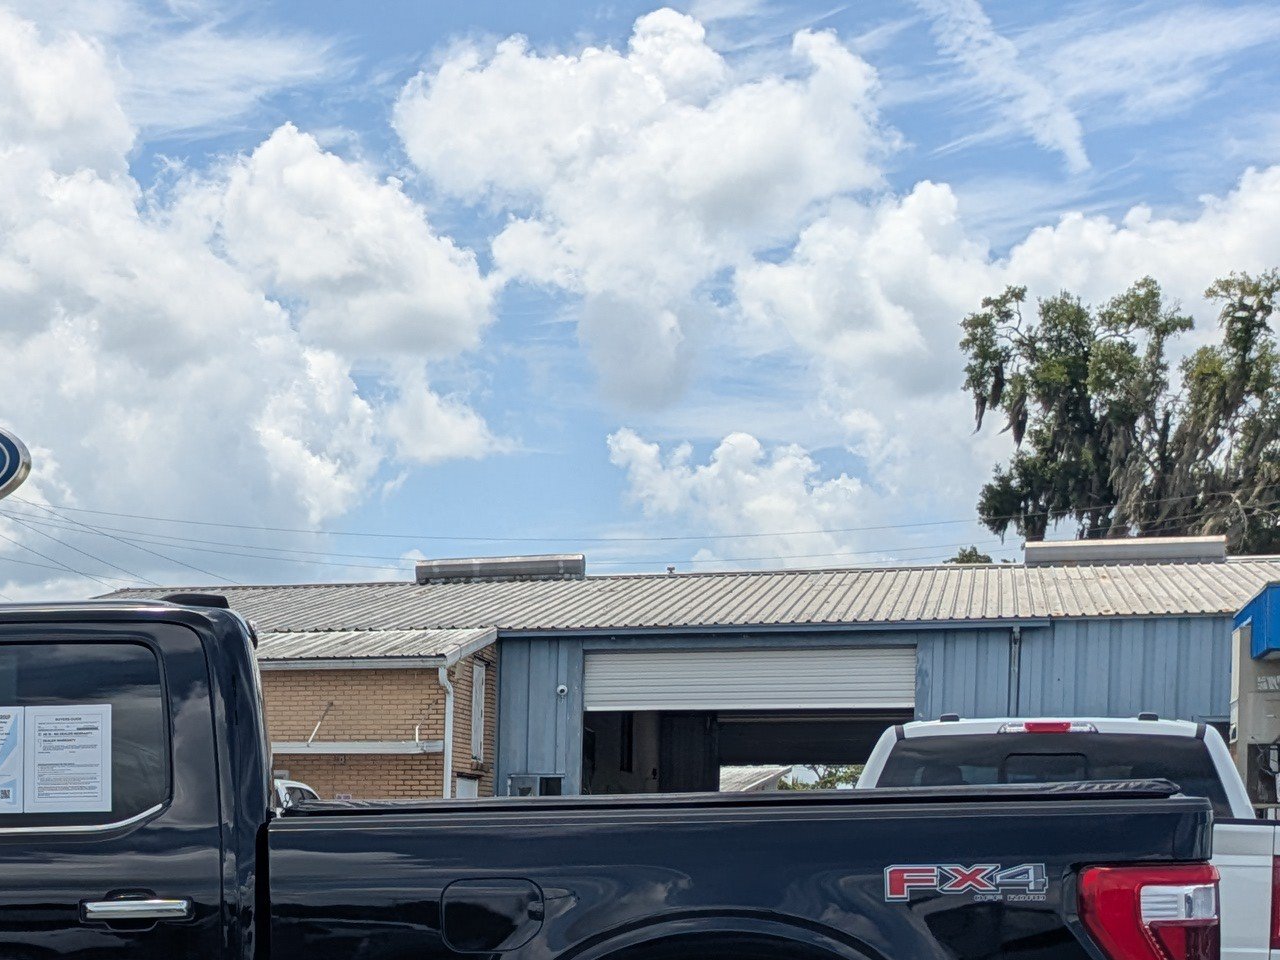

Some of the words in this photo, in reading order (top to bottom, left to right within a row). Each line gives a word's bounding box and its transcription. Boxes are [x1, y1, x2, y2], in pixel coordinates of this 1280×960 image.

[884, 863, 1048, 903] FX4
[974, 894, 1003, 902] OFF
[1007, 894, 1047, 902] ROAD
